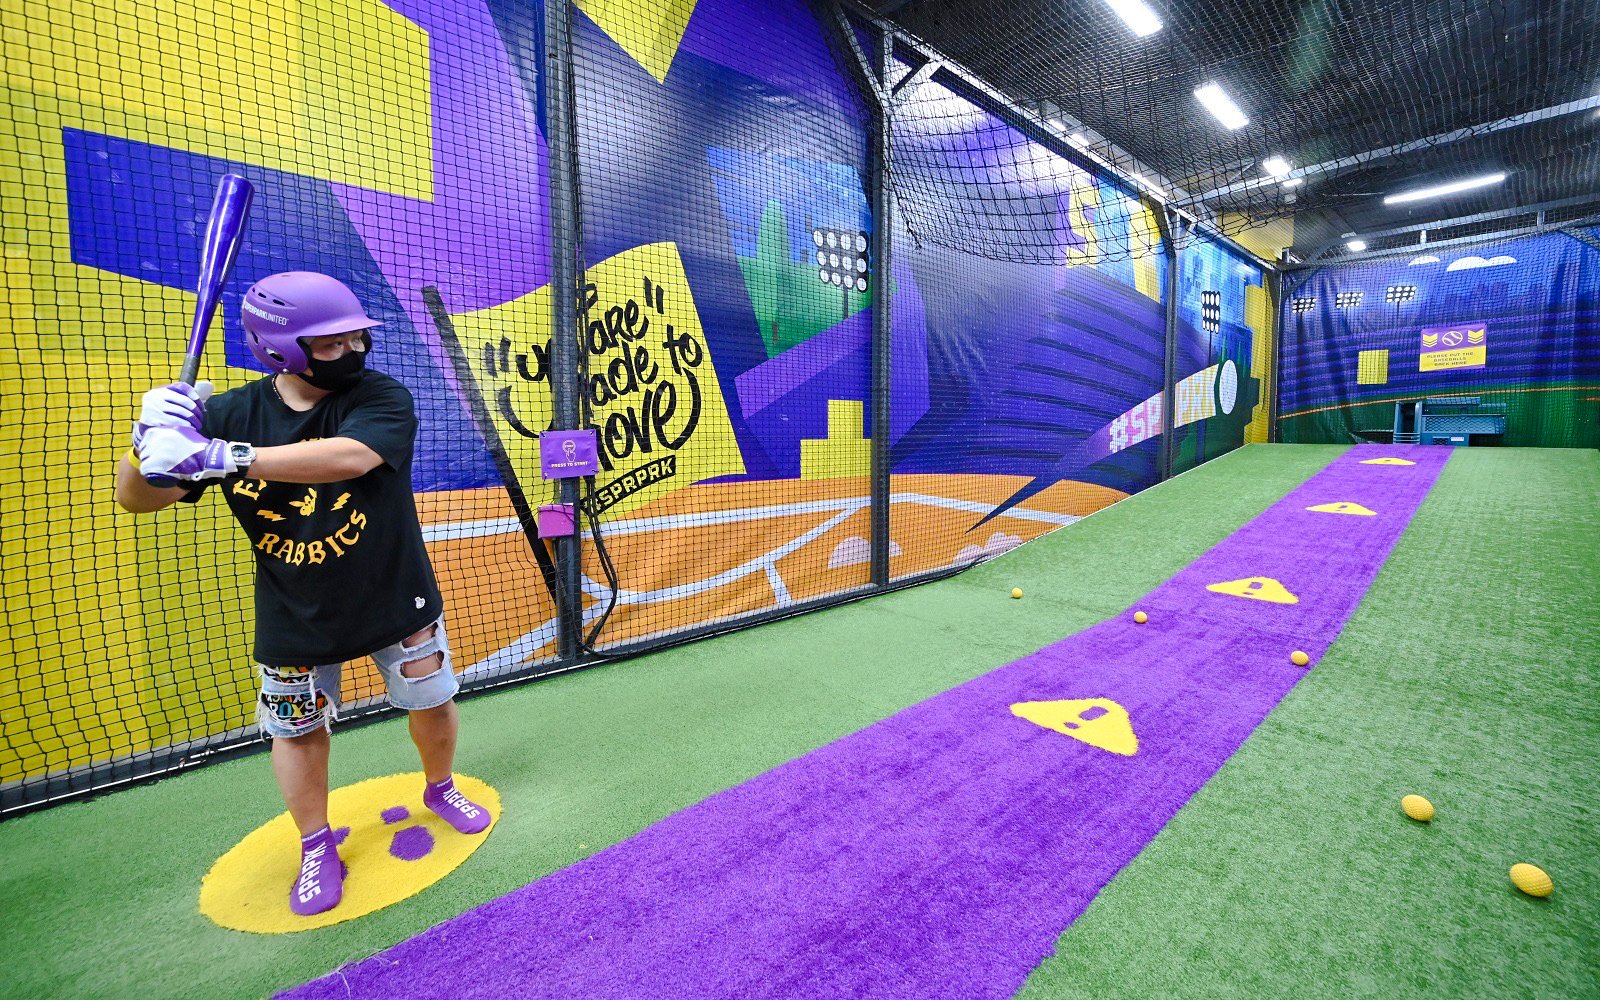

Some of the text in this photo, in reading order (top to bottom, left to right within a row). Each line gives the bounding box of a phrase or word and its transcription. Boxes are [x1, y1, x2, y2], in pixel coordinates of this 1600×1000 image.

[583, 324, 703, 406] ade to
[256, 509, 367, 566] RABBITS
